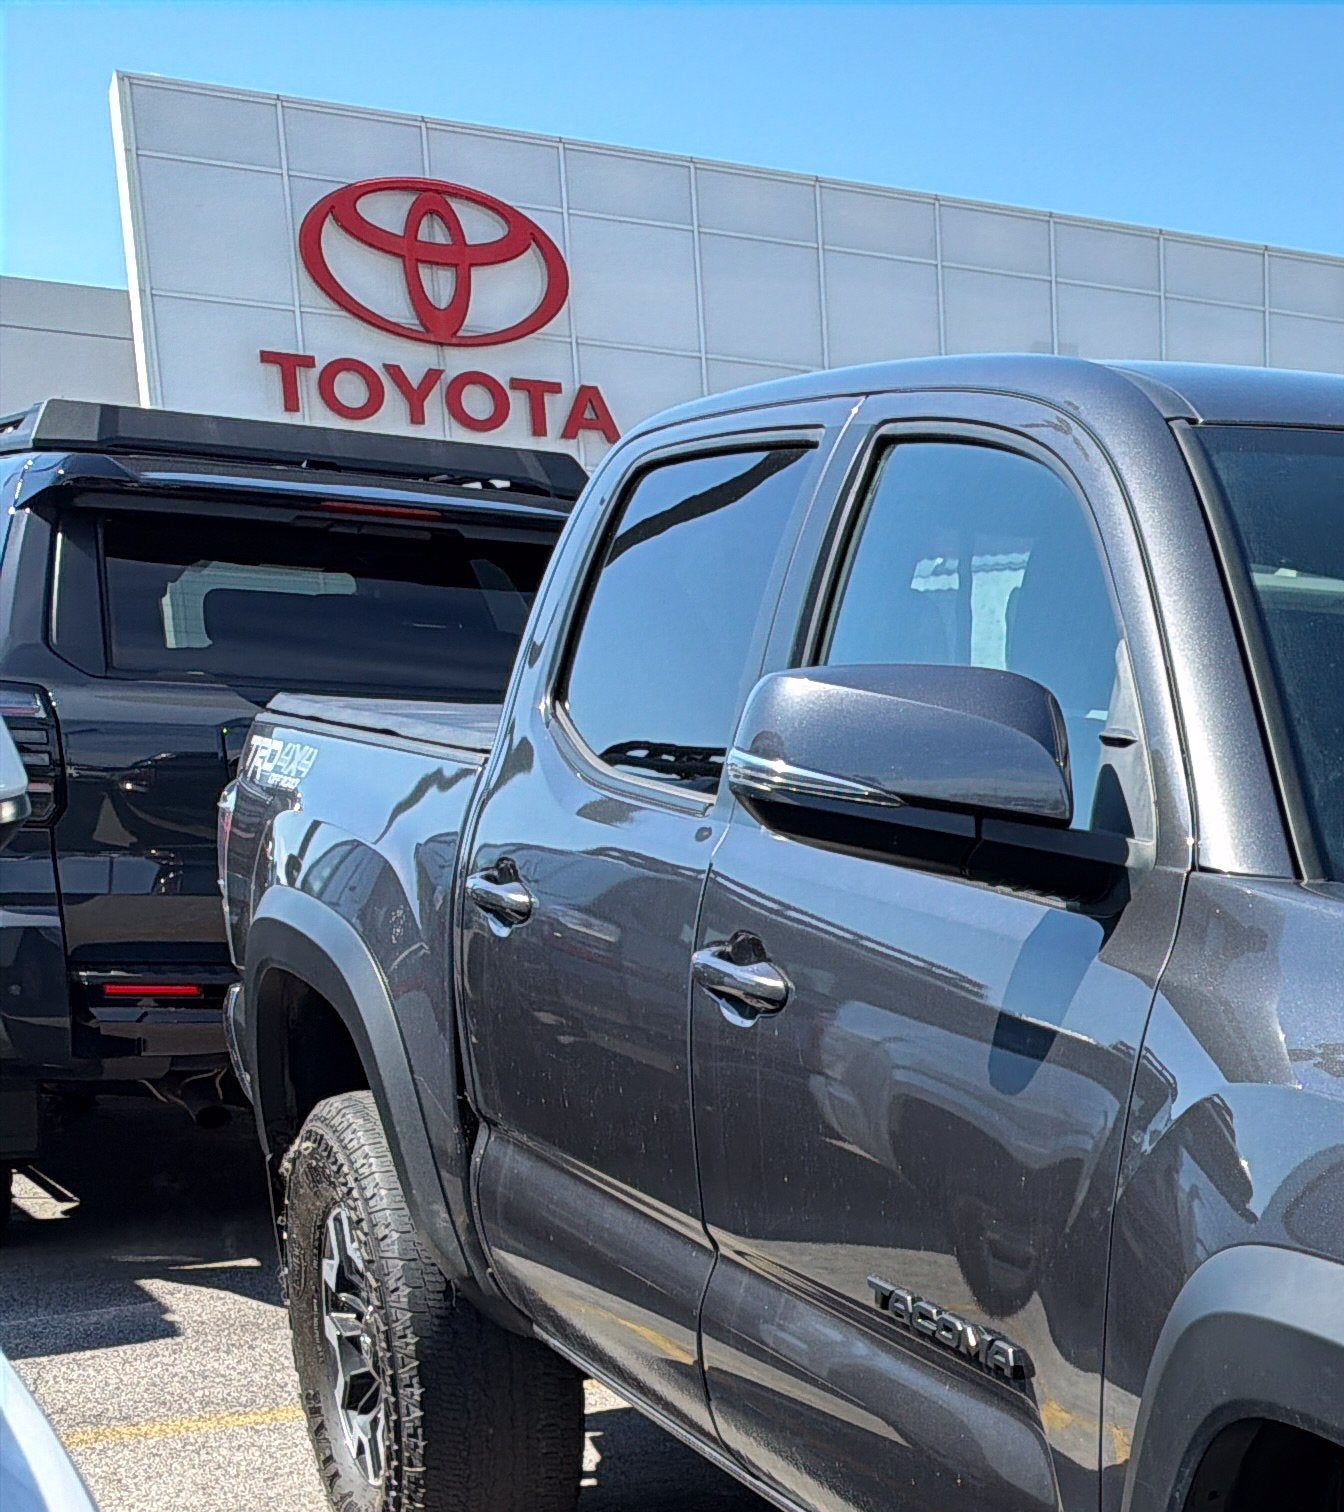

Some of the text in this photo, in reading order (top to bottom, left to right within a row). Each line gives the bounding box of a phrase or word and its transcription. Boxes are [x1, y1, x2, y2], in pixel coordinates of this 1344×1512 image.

[260, 350, 622, 443] TOYOTA
[246, 735, 284, 781] TRD
[866, 1274, 1015, 1379] TACOMA
